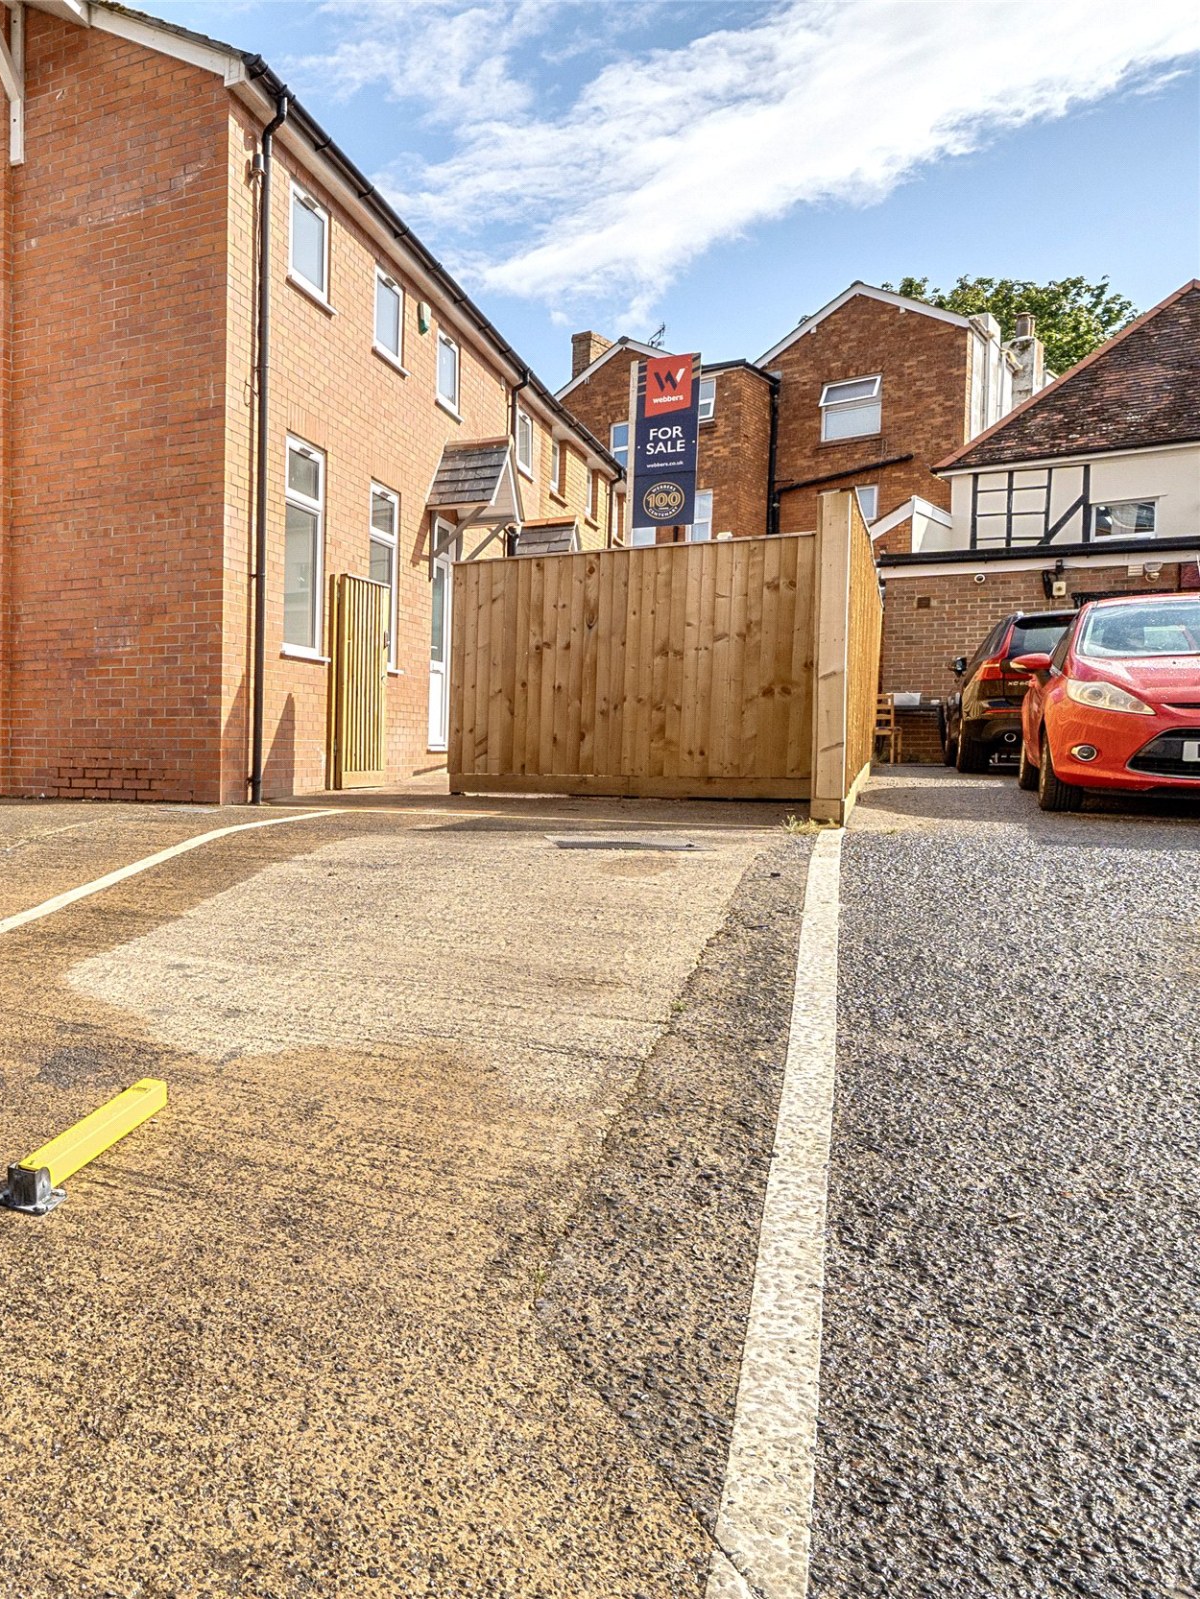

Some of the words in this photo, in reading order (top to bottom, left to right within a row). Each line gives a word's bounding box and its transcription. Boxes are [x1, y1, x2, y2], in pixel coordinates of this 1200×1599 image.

[652, 394, 684, 404] webbers
[649, 426, 683, 440] FOR
[646, 440, 685, 455] SALE
[646, 460, 684, 468] webbers.co.uk
[646, 492, 681, 508] 100
